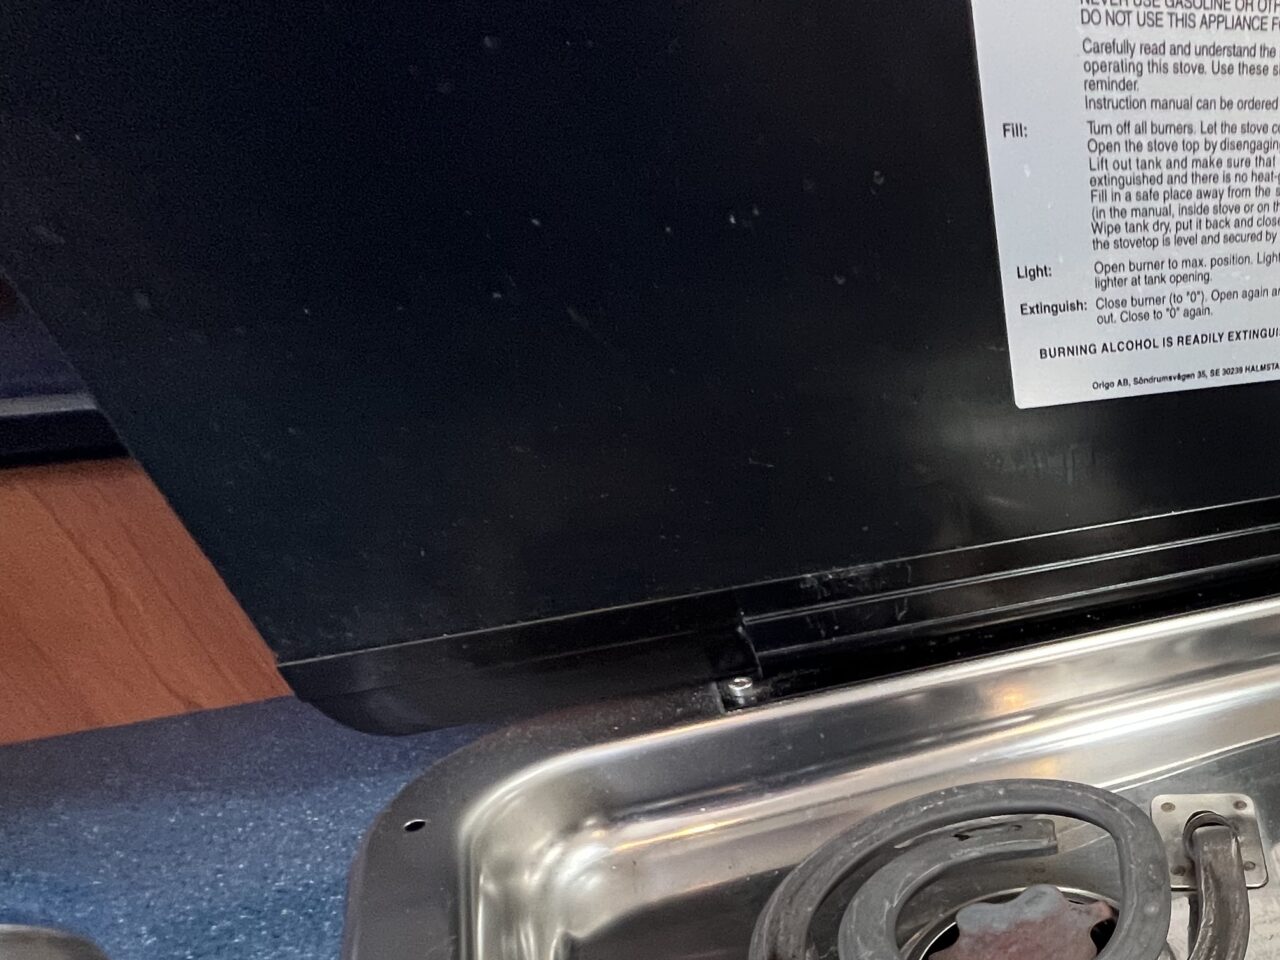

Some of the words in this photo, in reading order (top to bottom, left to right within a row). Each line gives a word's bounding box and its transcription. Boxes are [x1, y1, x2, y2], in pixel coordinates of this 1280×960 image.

[1080, 9, 1101, 26] DO
[1104, 10, 1130, 26] NOT
[1136, 11, 1163, 28] USE
[1169, 13, 1196, 29] THIS
[1199, 14, 1268, 31] APPLIANCE
[1082, 38, 1136, 58] Carefully
[1139, 40, 1166, 55] read
[1169, 41, 1191, 56] and
[1194, 41, 1256, 57] understand
[1259, 43, 1276, 58] the
[1082, 58, 1143, 77] operating
[1146, 59, 1168, 74] this
[1210, 60, 1234, 75] Use
[1237, 61, 1269, 75] these
[1084, 96, 1146, 110] Instruction
[1150, 96, 1192, 109] manual
[1195, 99, 1216, 110] can
[1219, 96, 1233, 110] be
[1236, 96, 1278, 110] ordered
[1002, 124, 1027, 138] Fill:
[1088, 120, 1112, 135] Turn
[1115, 120, 1130, 134] off
[1134, 120, 1147, 134] all
[1199, 120, 1217, 134] Let
[1220, 120, 1237, 134] the
[1240, 120, 1268, 133] stove
[1092, 237, 1110, 250] the
[1112, 235, 1159, 253] stovetop
[1161, 234, 1170, 247] is
[1173, 233, 1198, 247] level
[1200, 232, 1220, 246] and
[1222, 230, 1262, 244] secured
[1264, 230, 1277, 245] by
[1016, 265, 1051, 282] Light:
[1093, 259, 1125, 278] Open
[1128, 257, 1164, 272] burner
[1167, 257, 1178, 270] to
[1256, 251, 1280, 268] Light
[1094, 274, 1127, 292] lighter
[1130, 274, 1141, 287] at
[1143, 272, 1166, 286] tank
[1020, 299, 1086, 318] Extinguish:
[1095, 295, 1127, 310] Close
[1130, 292, 1165, 307] burner
[1168, 291, 1183, 307] (to
[1210, 287, 1238, 304] Open
[1241, 285, 1268, 302] again
[1119, 308, 1150, 323] Close
[1152, 308, 1162, 320] to
[1039, 343, 1097, 360] BURNING
[1101, 339, 1159, 353] ALCOHOL
[1163, 335, 1173, 346] IS
[1177, 332, 1224, 346] READILY
